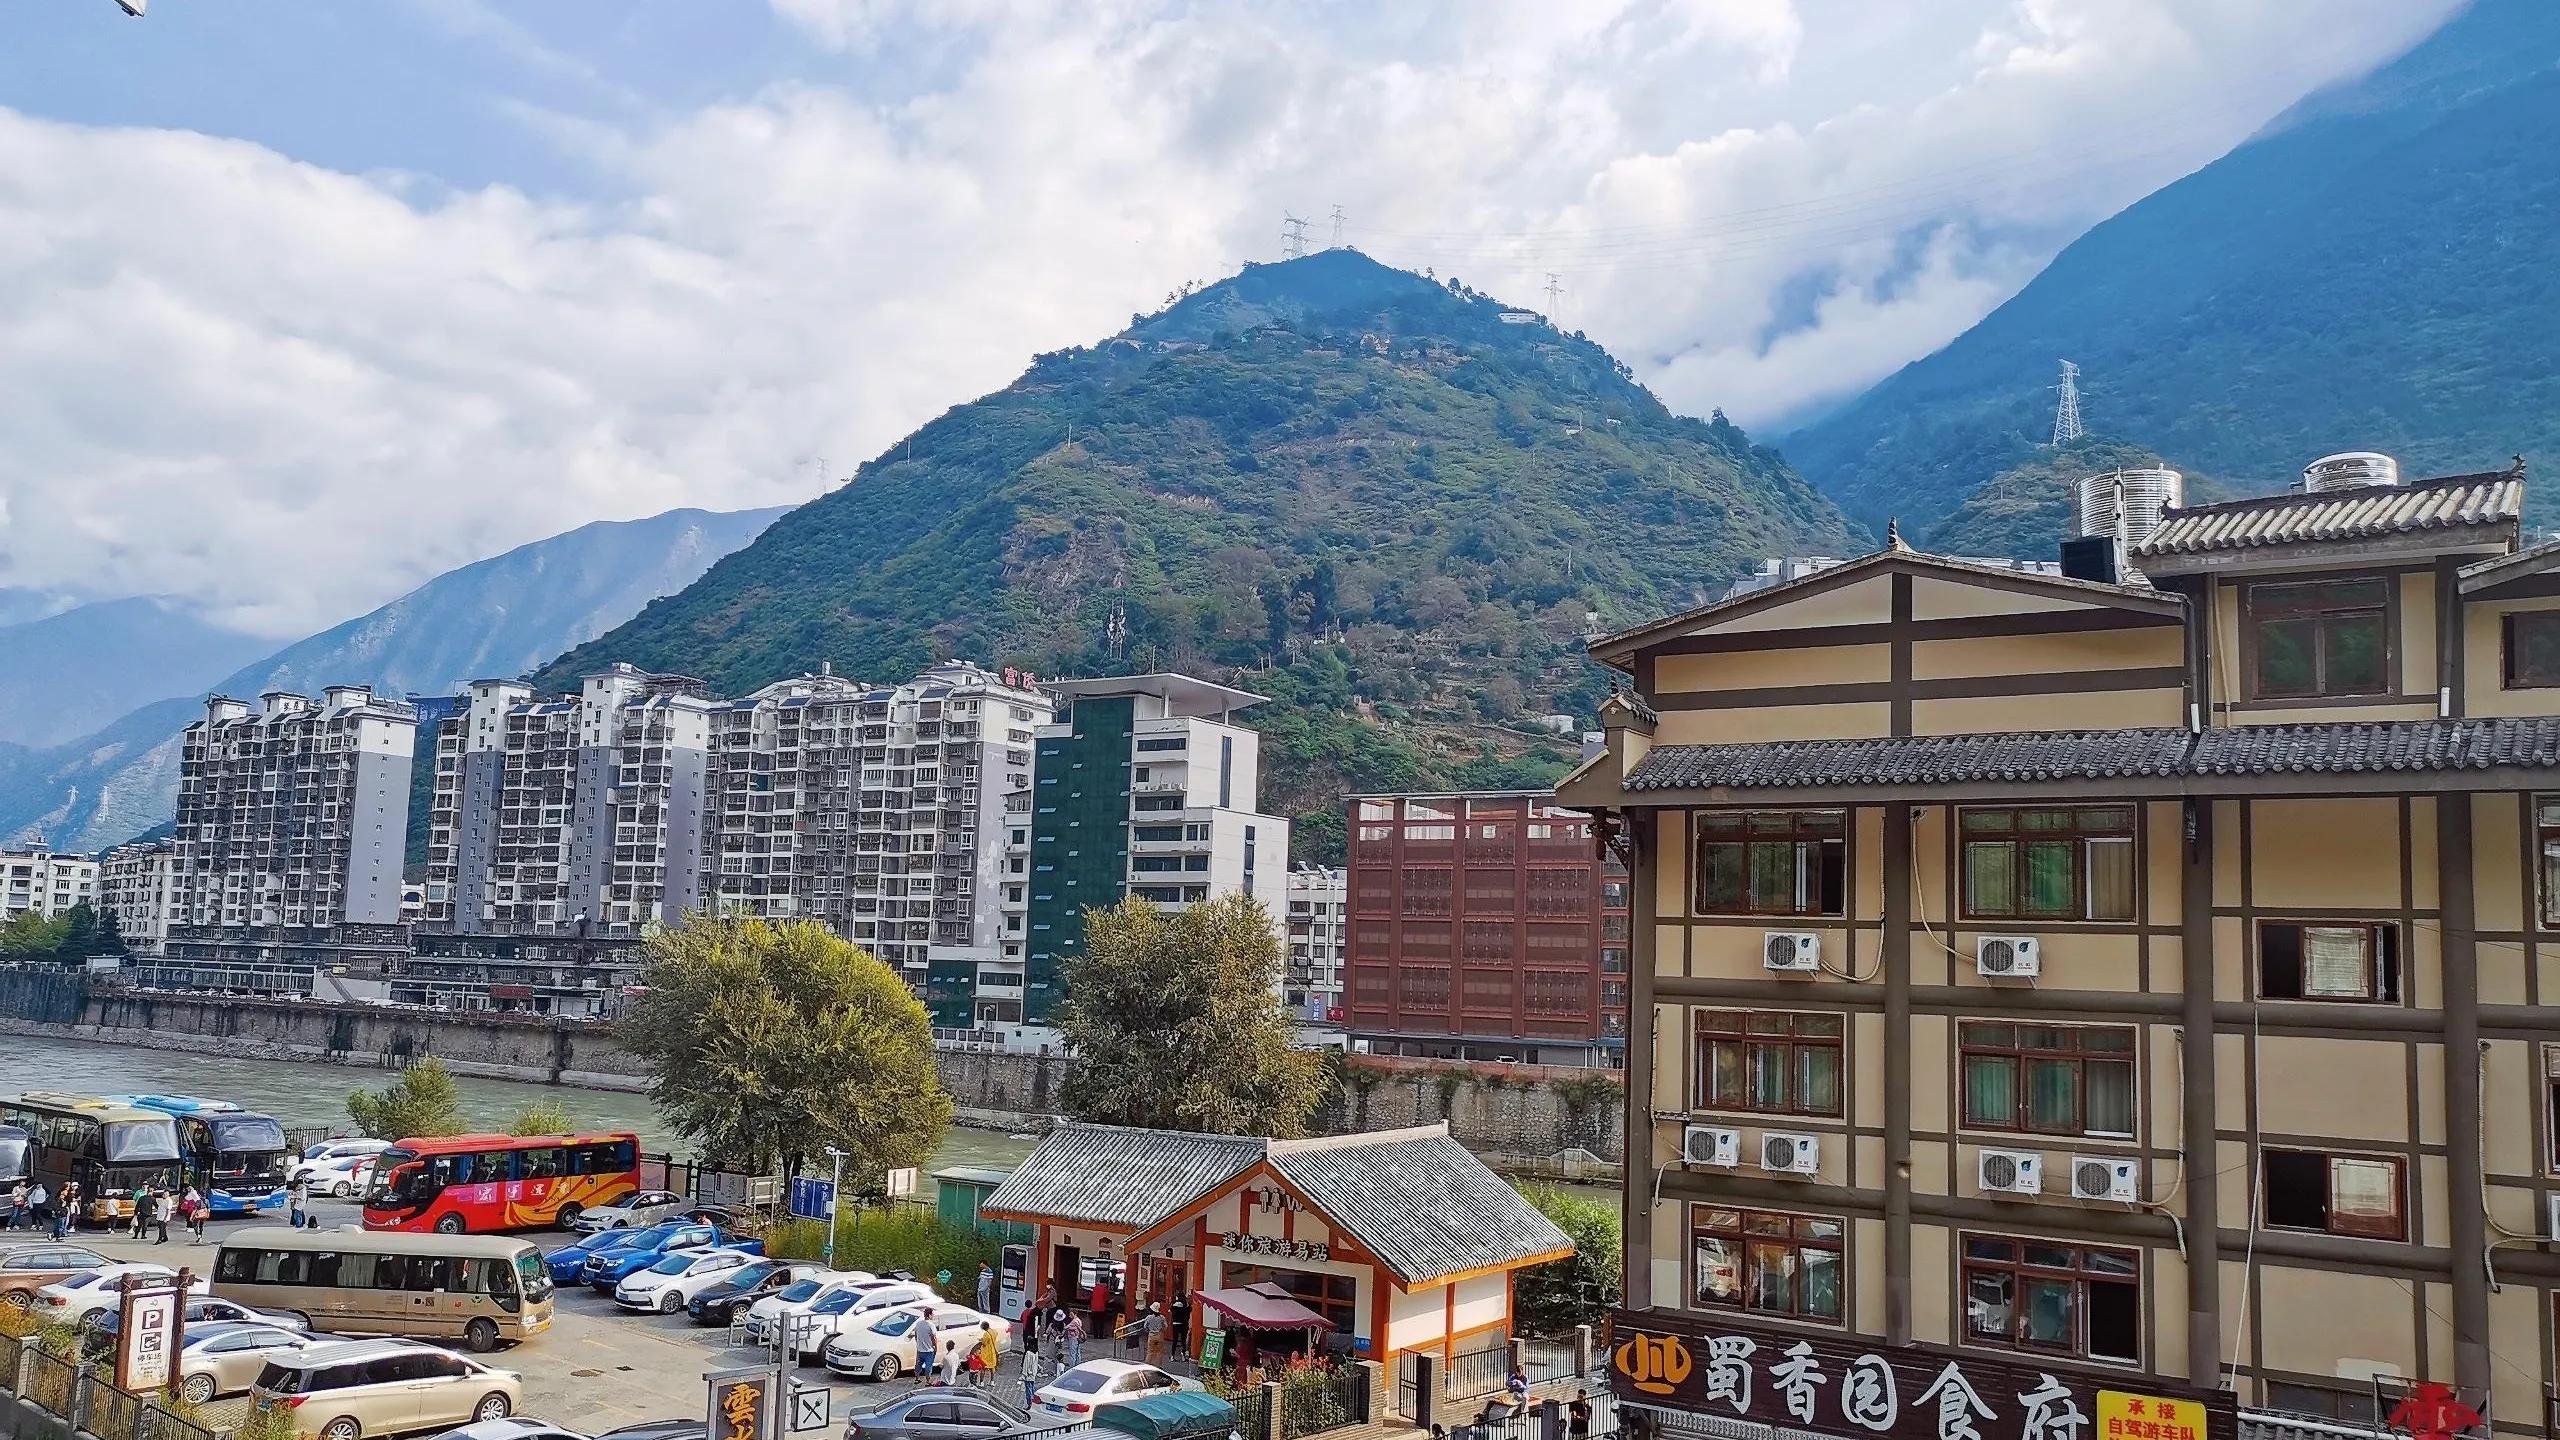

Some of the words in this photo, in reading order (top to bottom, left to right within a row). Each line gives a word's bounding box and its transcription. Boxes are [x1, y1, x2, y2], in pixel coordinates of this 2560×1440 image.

[1222, 1231, 1329, 1262] 迷你旅游易站
[145, 1310, 160, 1329] P
[2128, 1399, 2176, 1420] 承接
[2108, 1417, 2196, 1440] 自驾游车队
